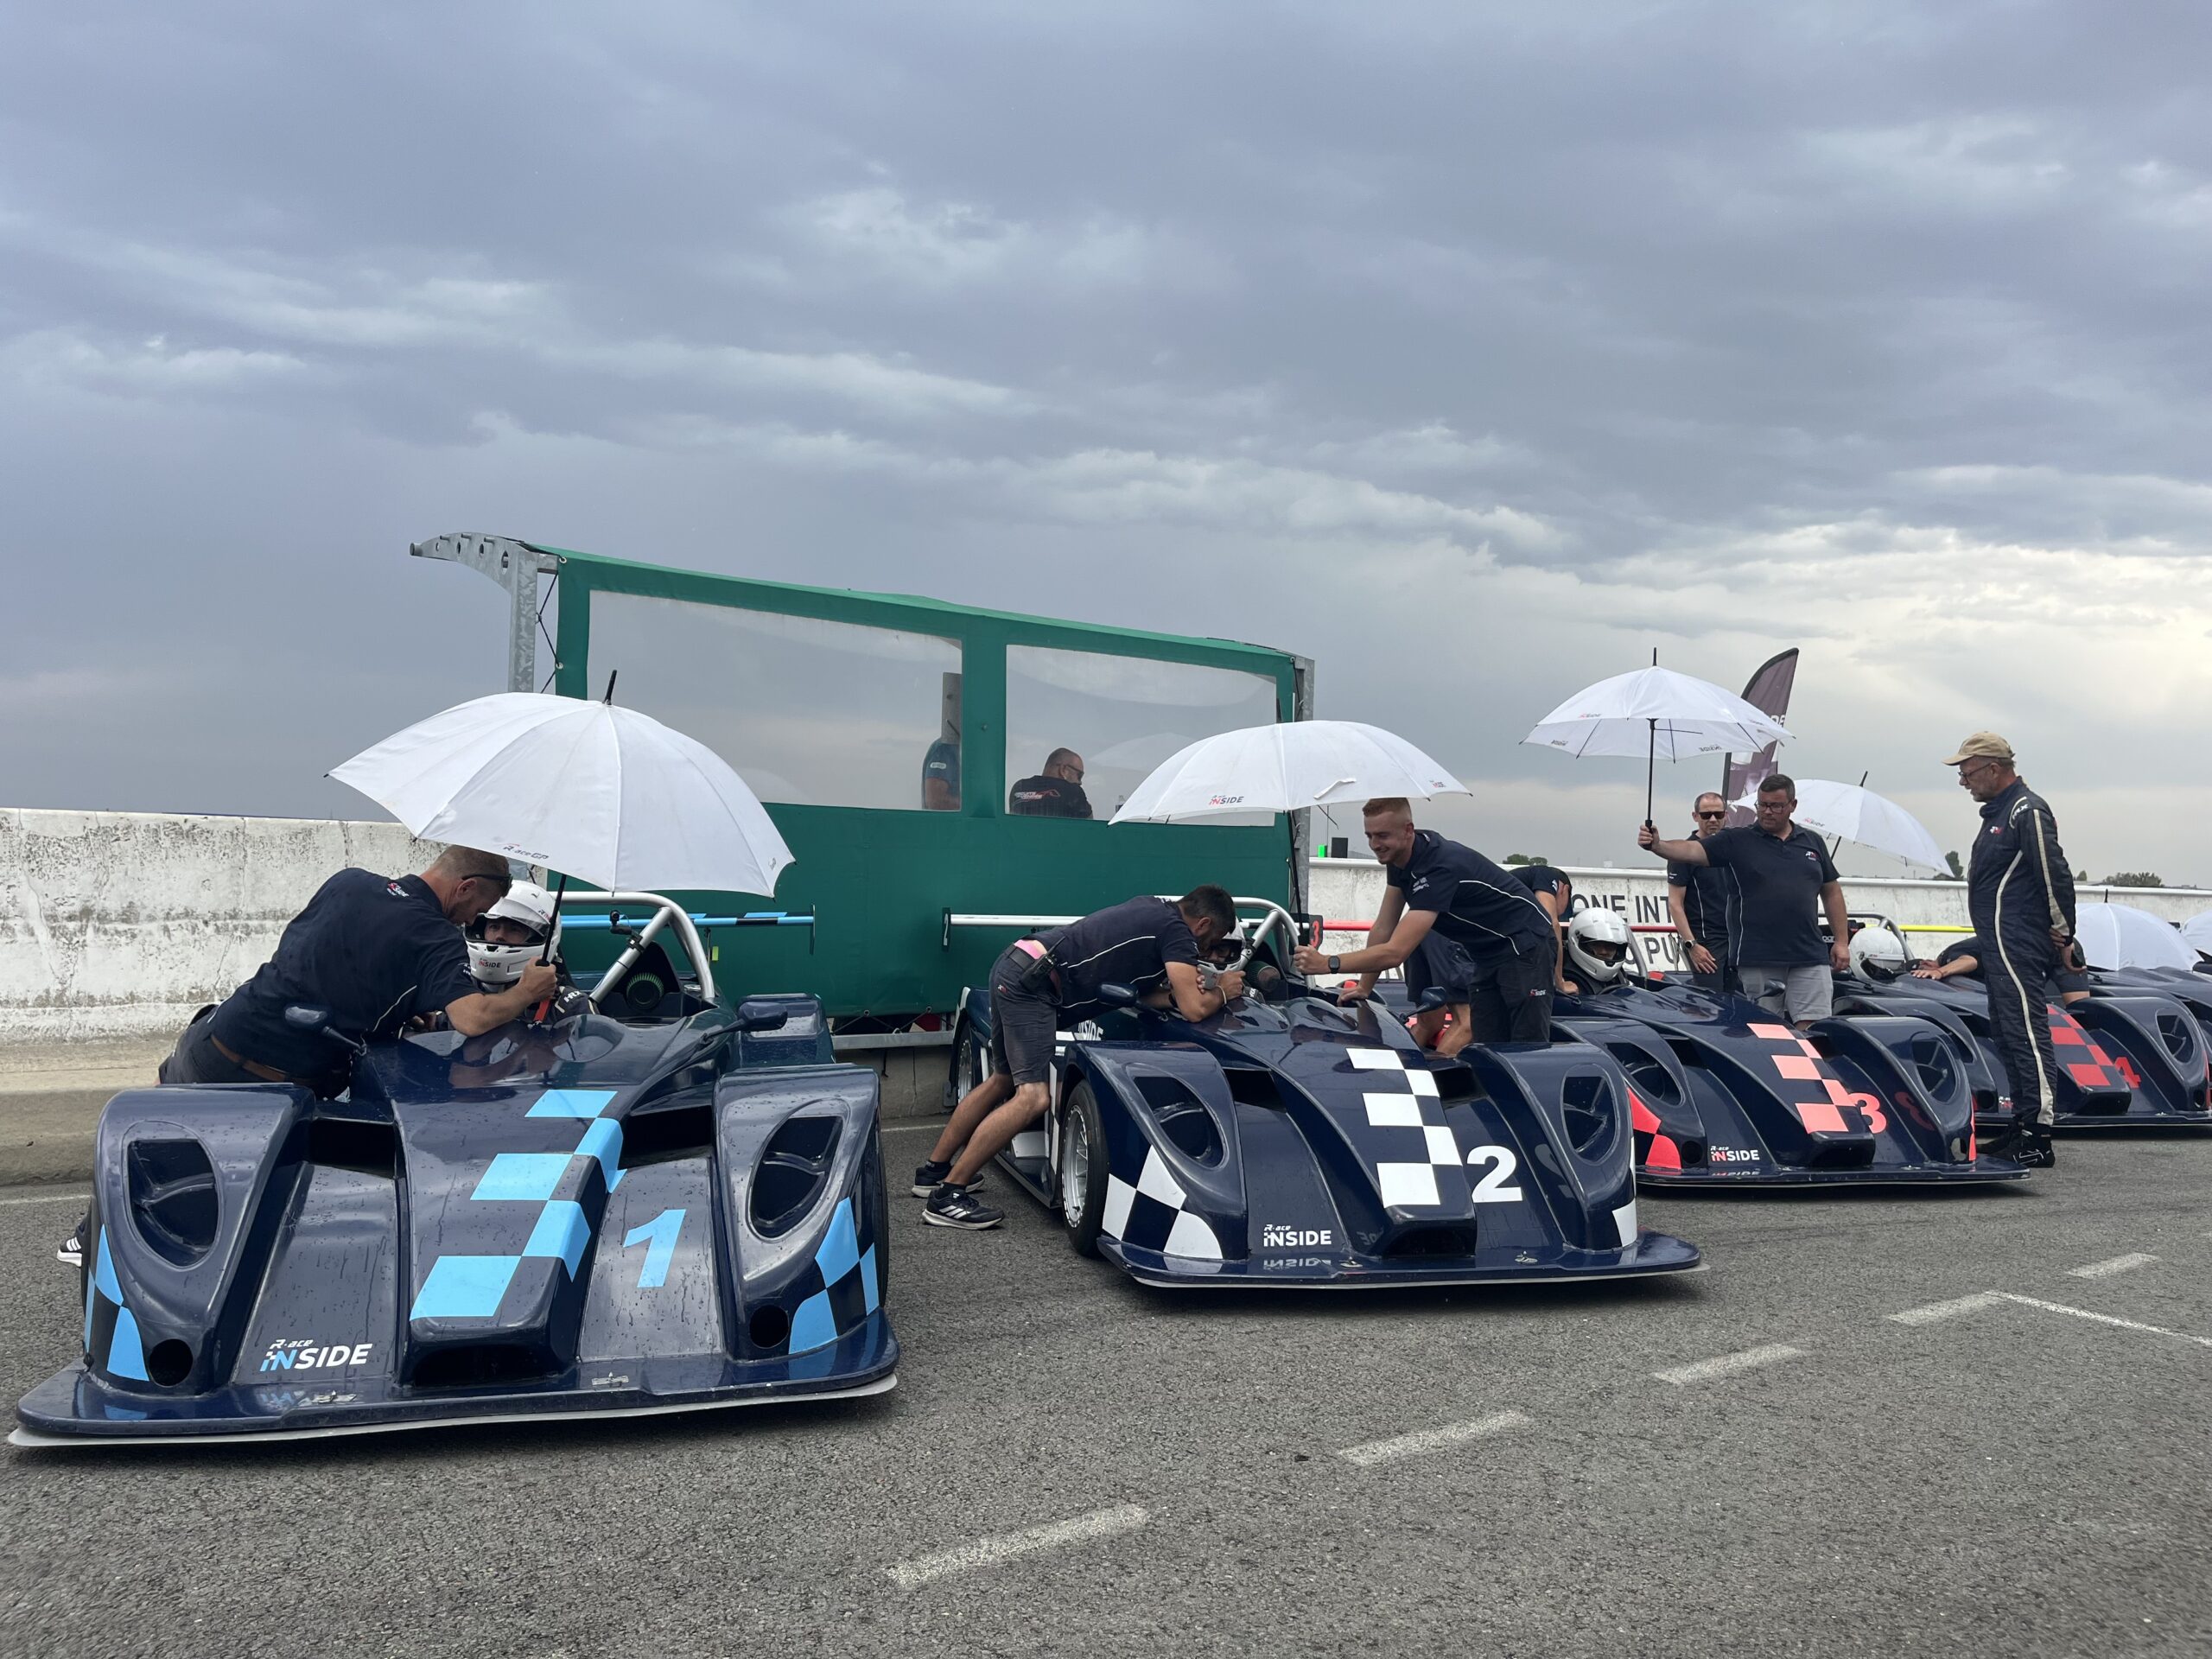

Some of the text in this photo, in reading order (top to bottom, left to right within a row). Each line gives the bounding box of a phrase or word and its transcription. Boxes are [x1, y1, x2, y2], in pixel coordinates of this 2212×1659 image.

[1311, 920, 1320, 948] 3
[1847, 1092, 1887, 1134] 3
[1466, 1145, 1523, 1204] 2
[622, 1209, 687, 1288] 1
